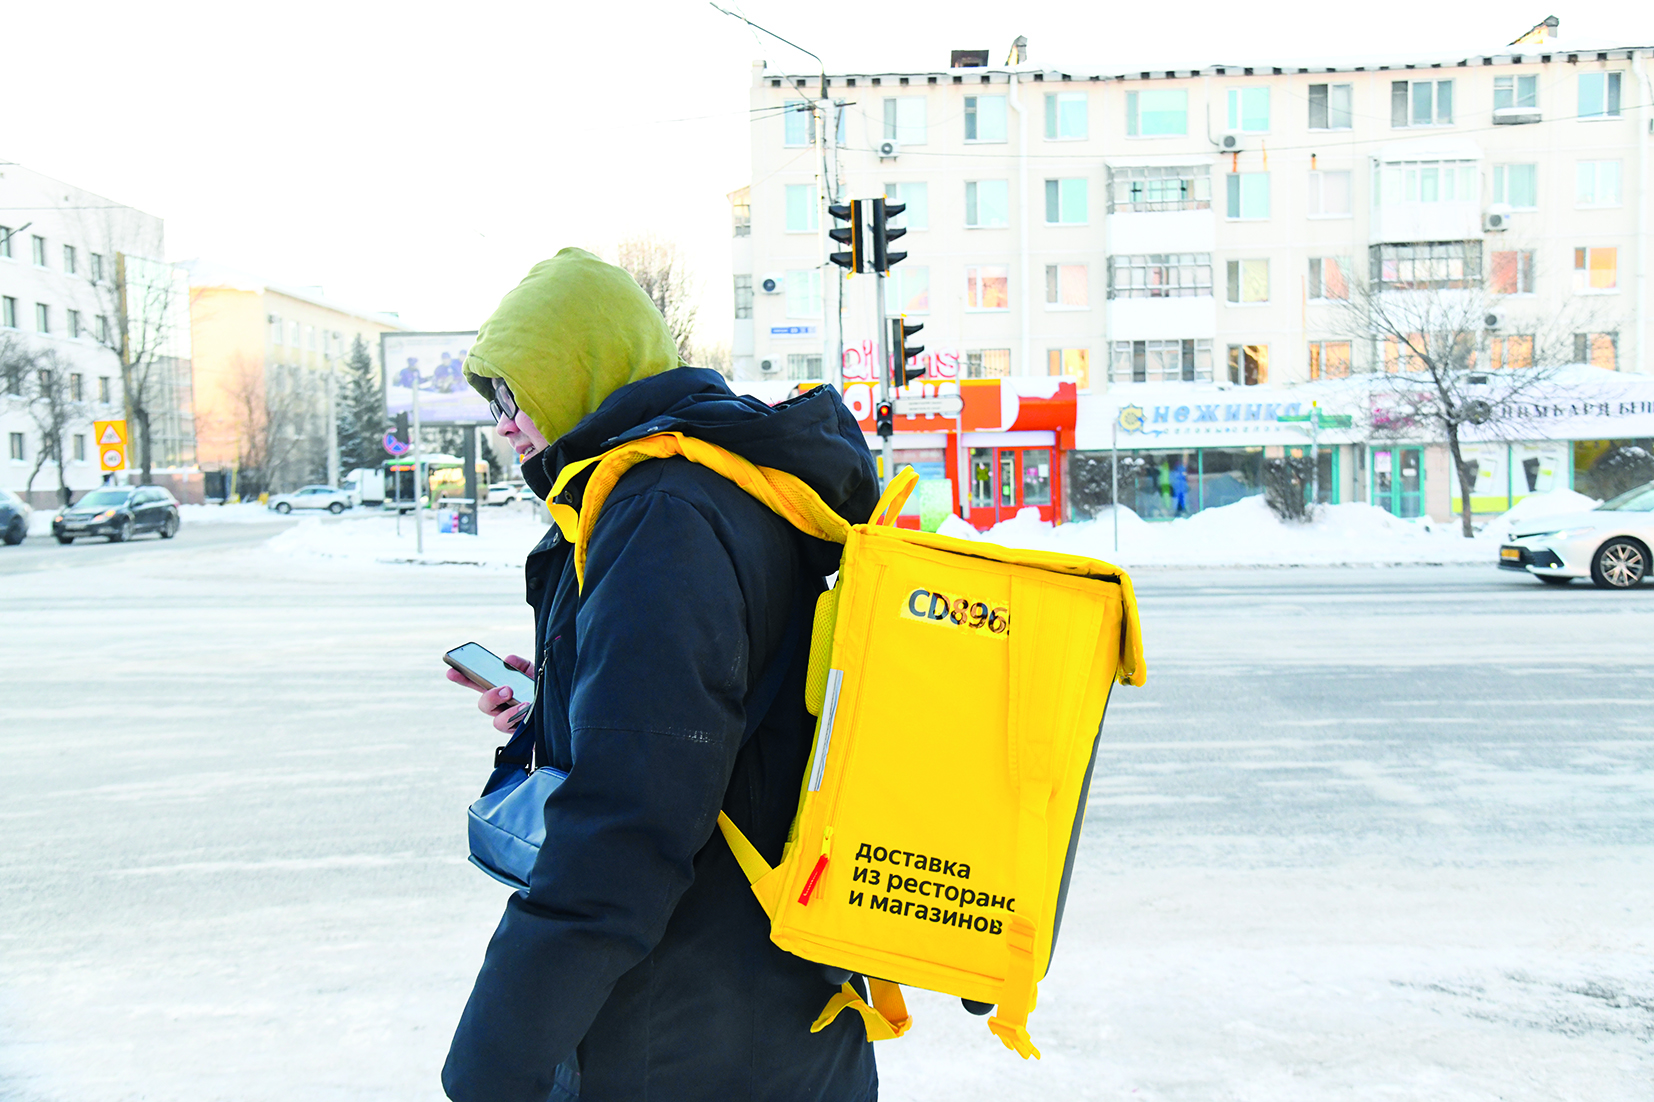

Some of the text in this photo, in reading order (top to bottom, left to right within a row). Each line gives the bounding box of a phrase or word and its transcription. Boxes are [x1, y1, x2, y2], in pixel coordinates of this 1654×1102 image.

[908, 589, 1011, 636] CD896
[852, 866, 881, 886] из
[855, 842, 971, 879] доставка
[848, 889, 1003, 935] и магазинов
